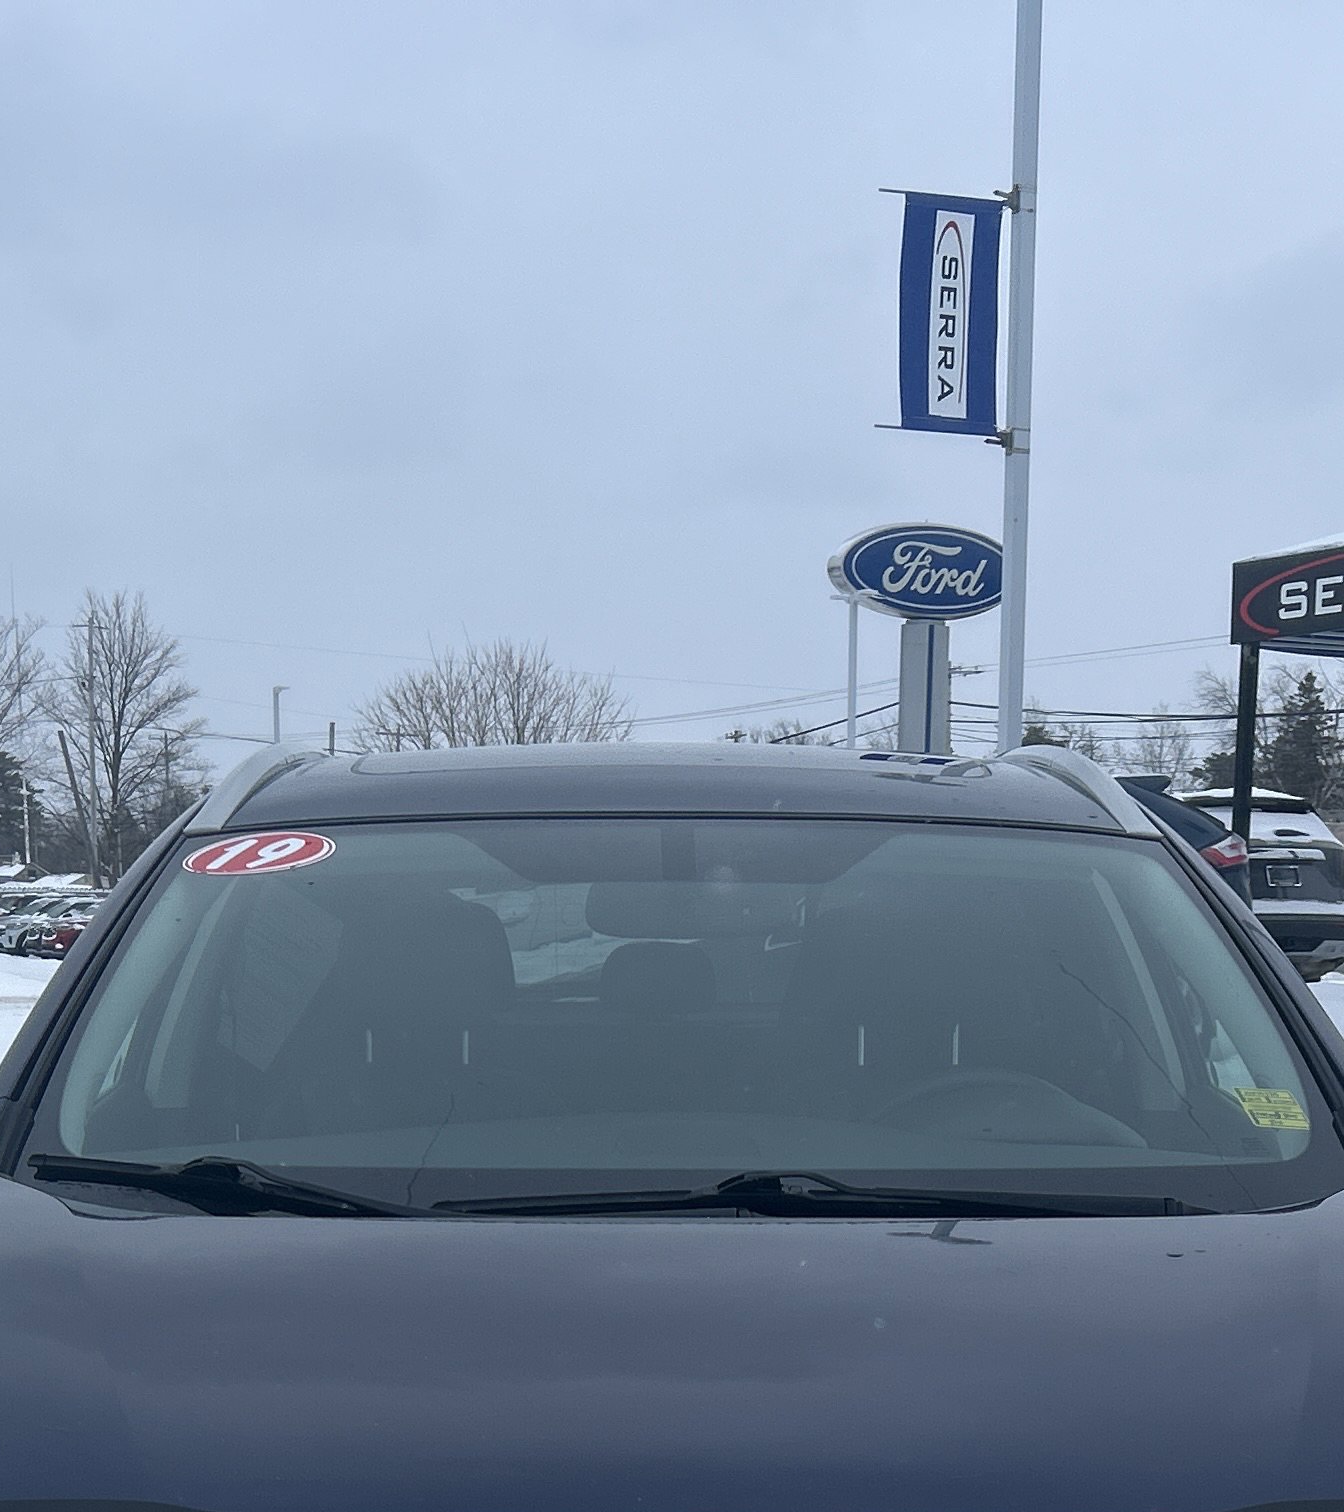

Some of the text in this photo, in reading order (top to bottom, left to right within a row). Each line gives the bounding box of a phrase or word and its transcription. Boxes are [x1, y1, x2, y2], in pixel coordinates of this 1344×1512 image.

[936, 254, 960, 403] SERRA
[882, 541, 988, 597] Ford
[206, 837, 306, 870] 19
